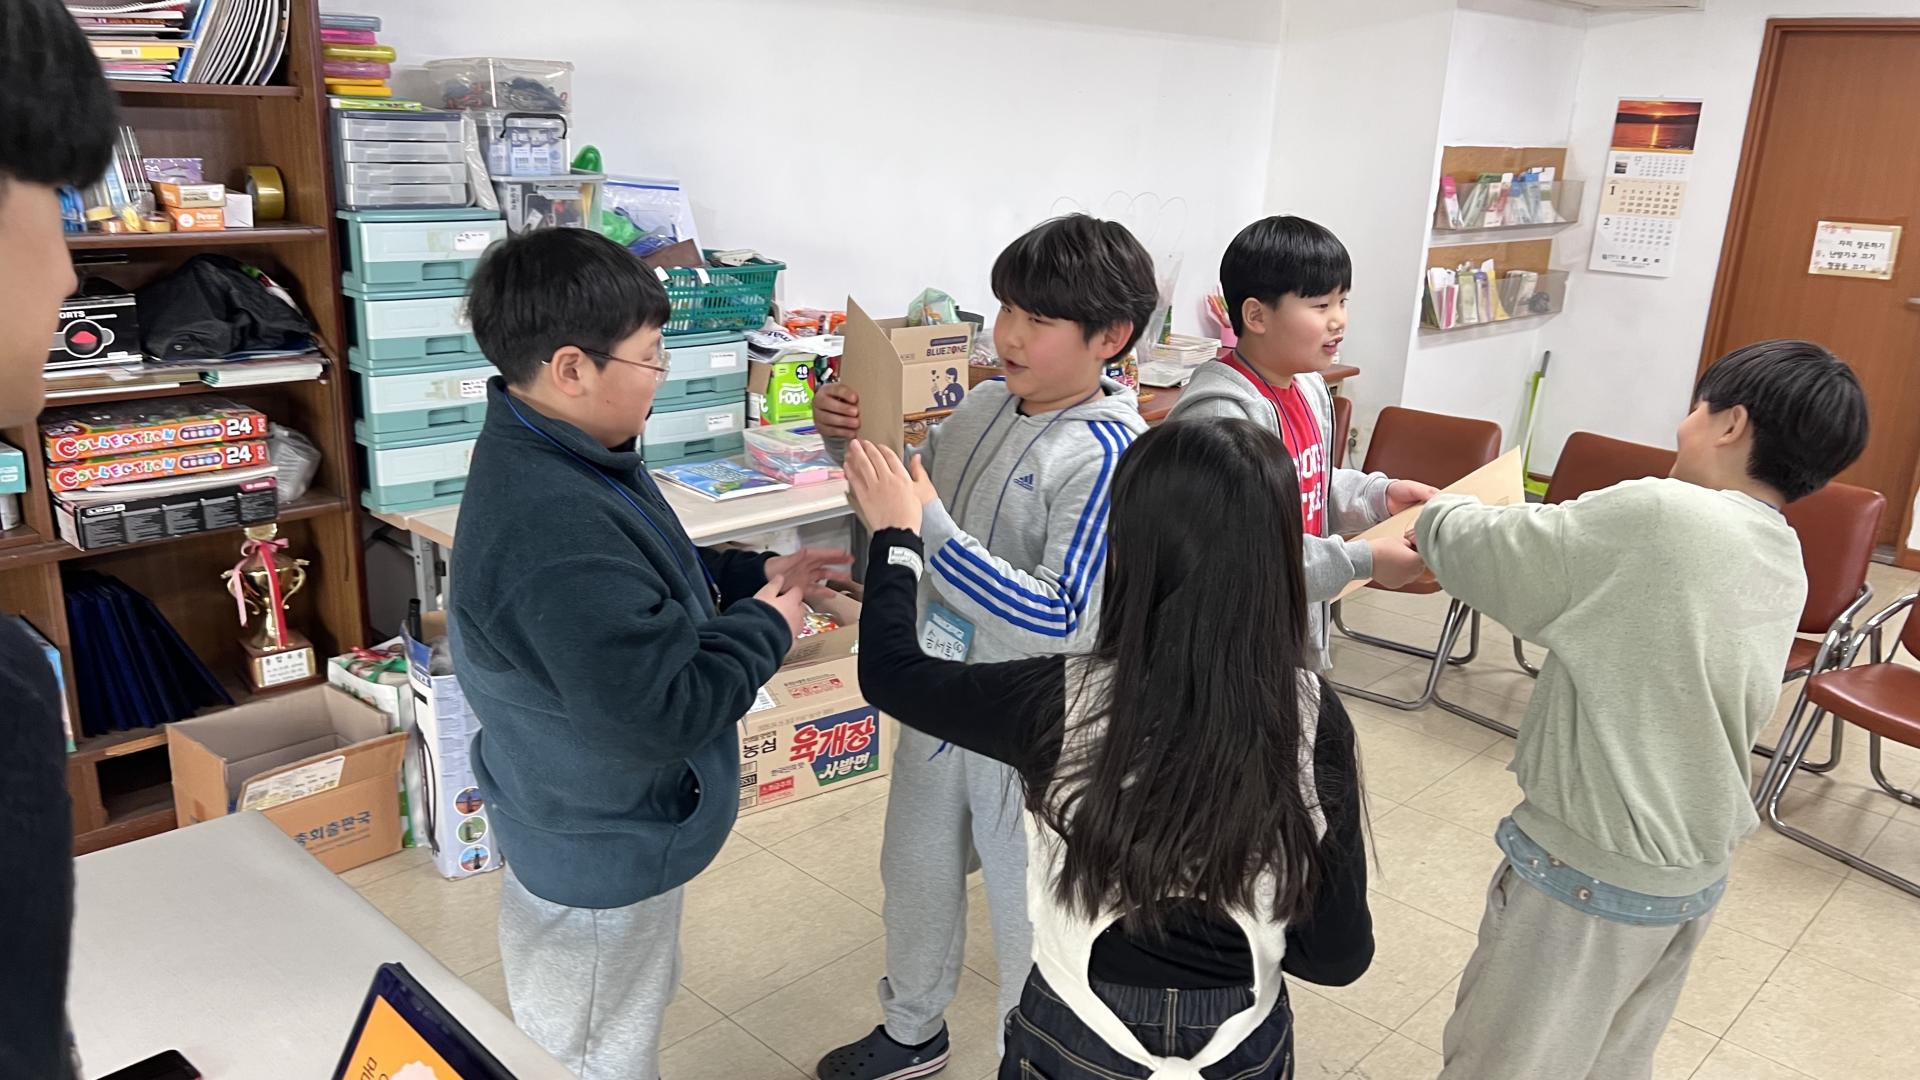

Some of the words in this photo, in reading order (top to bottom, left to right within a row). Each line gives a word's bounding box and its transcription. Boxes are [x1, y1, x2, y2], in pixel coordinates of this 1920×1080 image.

[926, 345, 968, 356] BLUEZONE
[796, 366, 809, 375] 48
[226, 418, 252, 436] 24
[226, 445, 252, 464] 24
[743, 737, 776, 759] 농심
[789, 715, 876, 763] 육개장
[818, 751, 871, 780] 사발면
